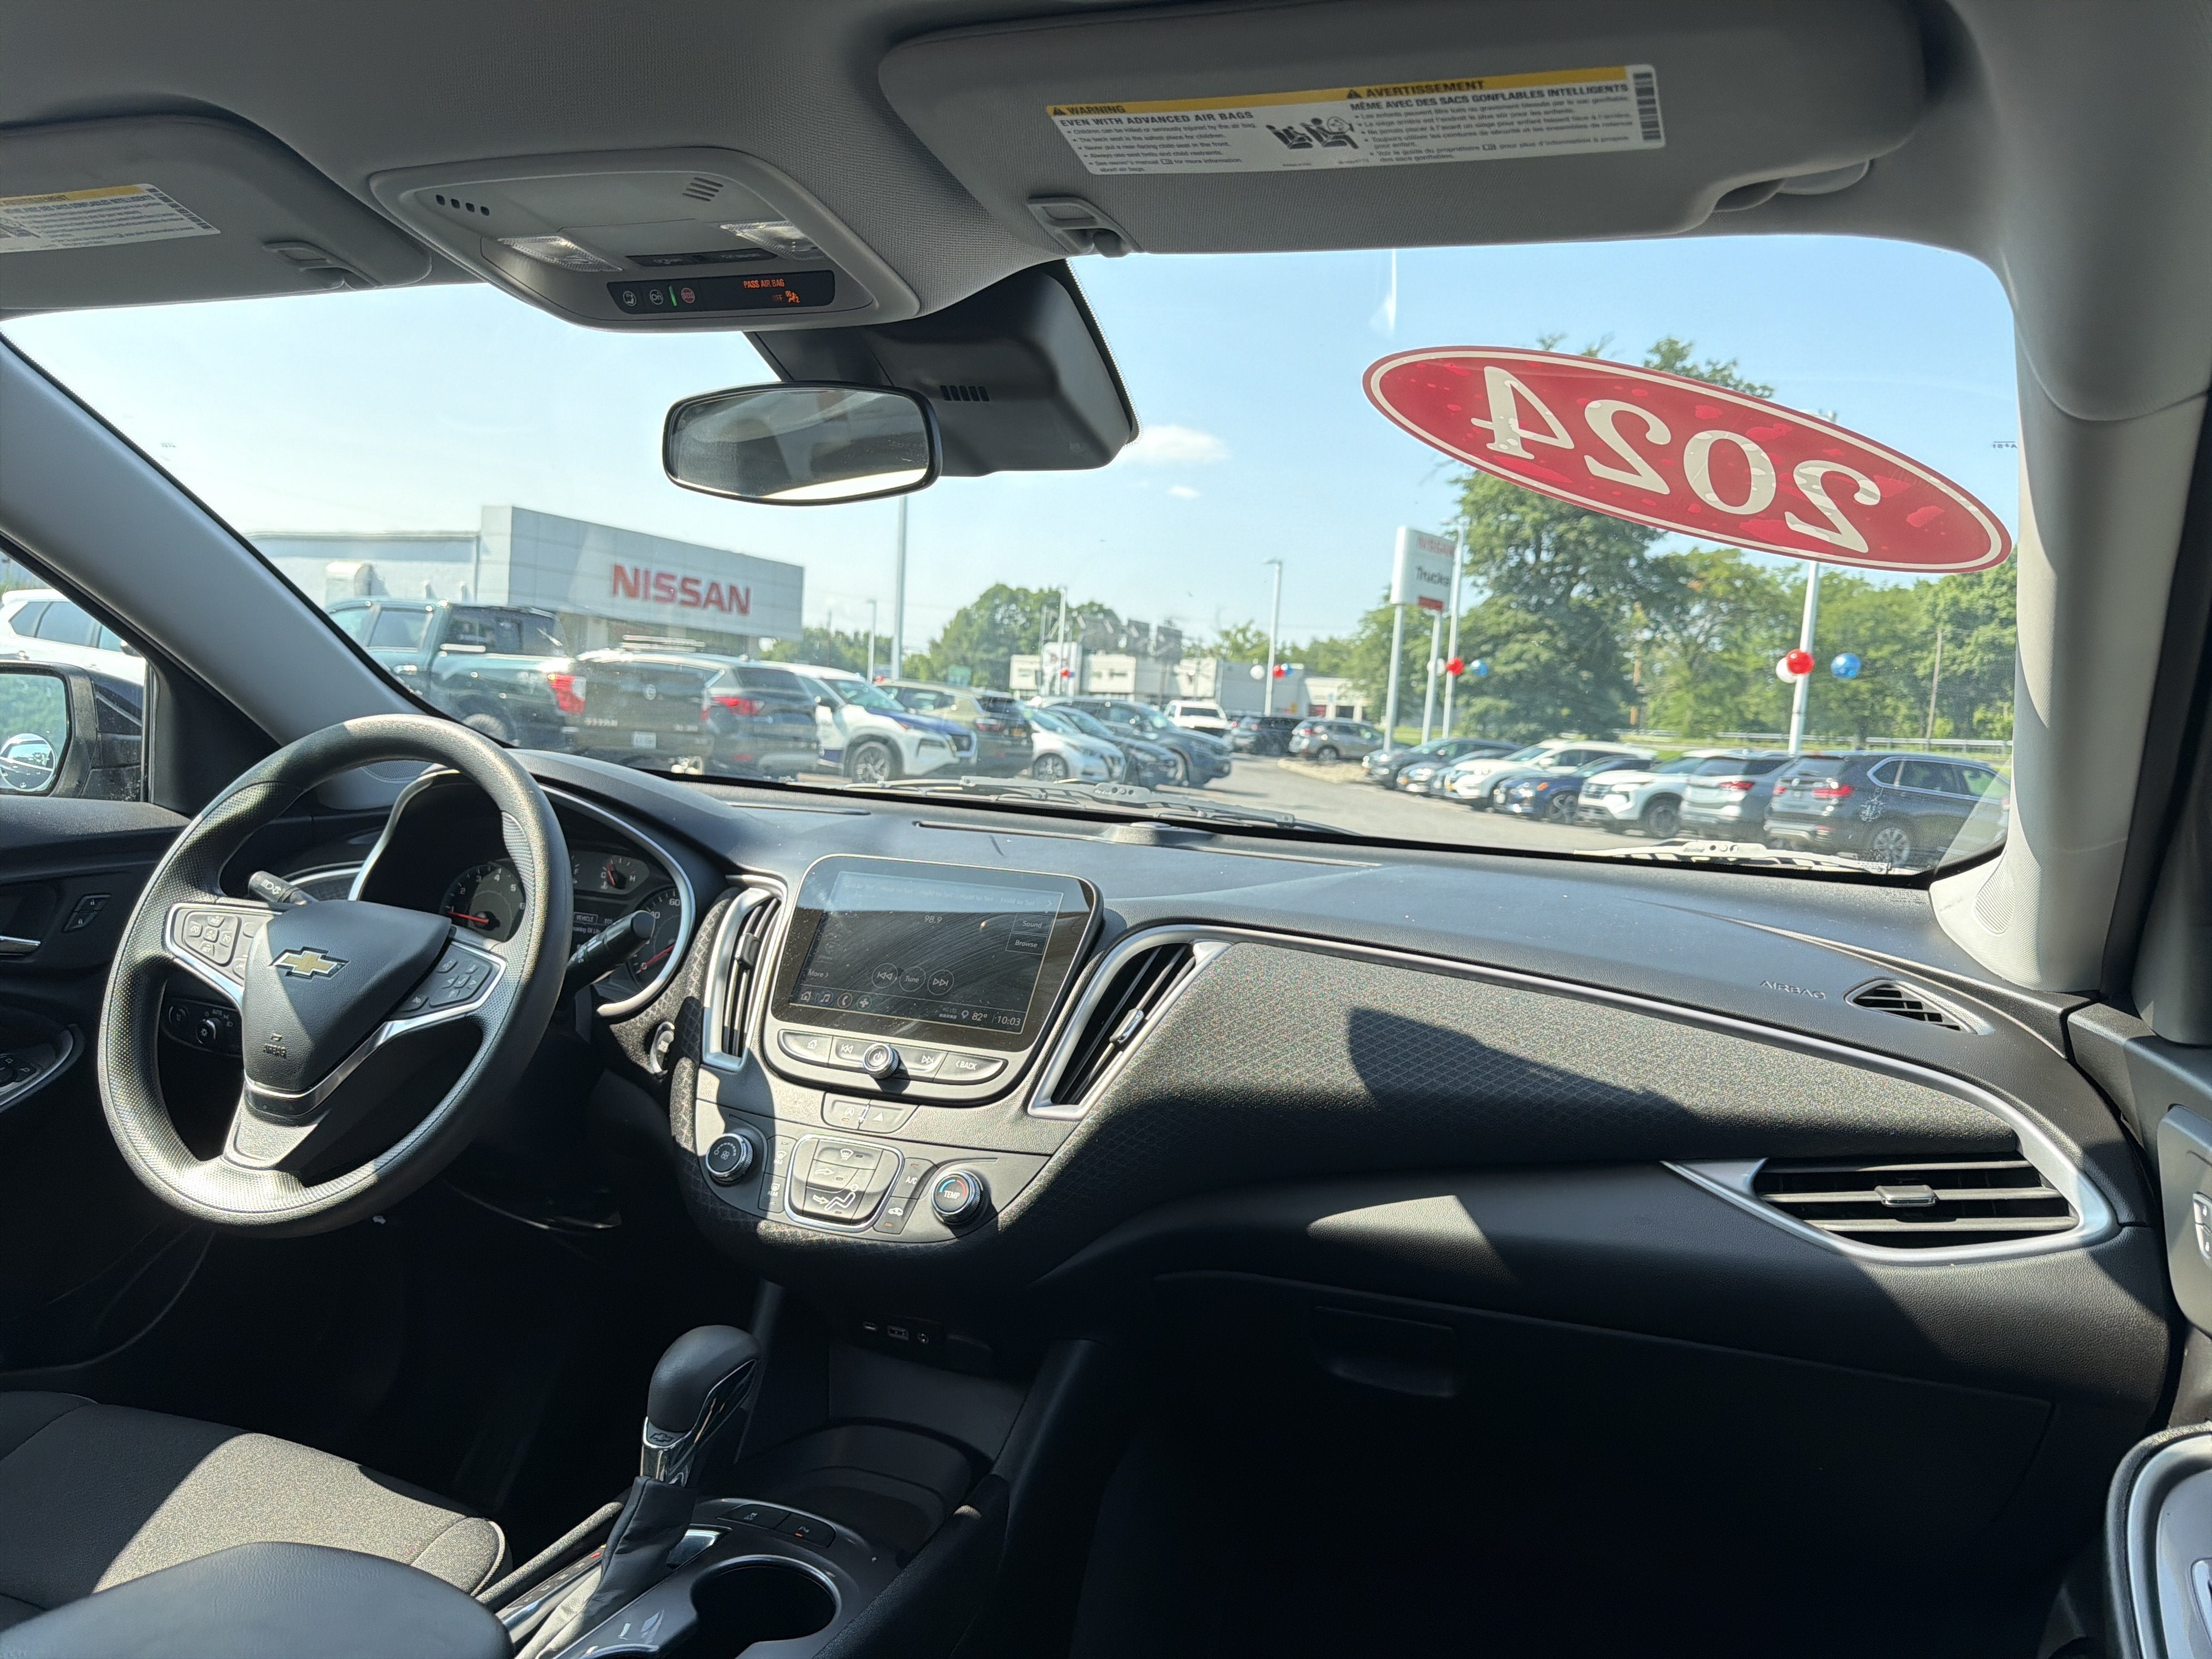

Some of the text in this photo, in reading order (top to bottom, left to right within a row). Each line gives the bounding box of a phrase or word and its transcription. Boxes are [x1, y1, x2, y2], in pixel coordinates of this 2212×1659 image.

[1366, 80, 1484, 97] AVERTISSEMENT
[1348, 83, 1629, 110] MÊME AVEC DES SACS GONFLABLES INTELLIGENTS
[1066, 105, 1126, 115] WARNING
[1091, 117, 1124, 125] WITH
[1125, 114, 1191, 125] ADVANCED
[1217, 111, 1254, 120] BAGS
[744, 278, 785, 289] PASS AIR BAG
[682, 292, 695, 300] SOS
[611, 562, 752, 616] NISSAN
[577, 914, 594, 922] VEHICLE
[924, 915, 943, 923] 98.9
[1015, 939, 1038, 947] Browse
[808, 968, 825, 978] More
[905, 975, 919, 983] Tune
[1759, 980, 1826, 1000] AIRBAG
[972, 1012, 988, 1022] 82°
[997, 1015, 1021, 1026] 10:03
[960, 1060, 978, 1070] BACK
[905, 1176, 918, 1186] A/C
[944, 1190, 961, 1199] TEMP
